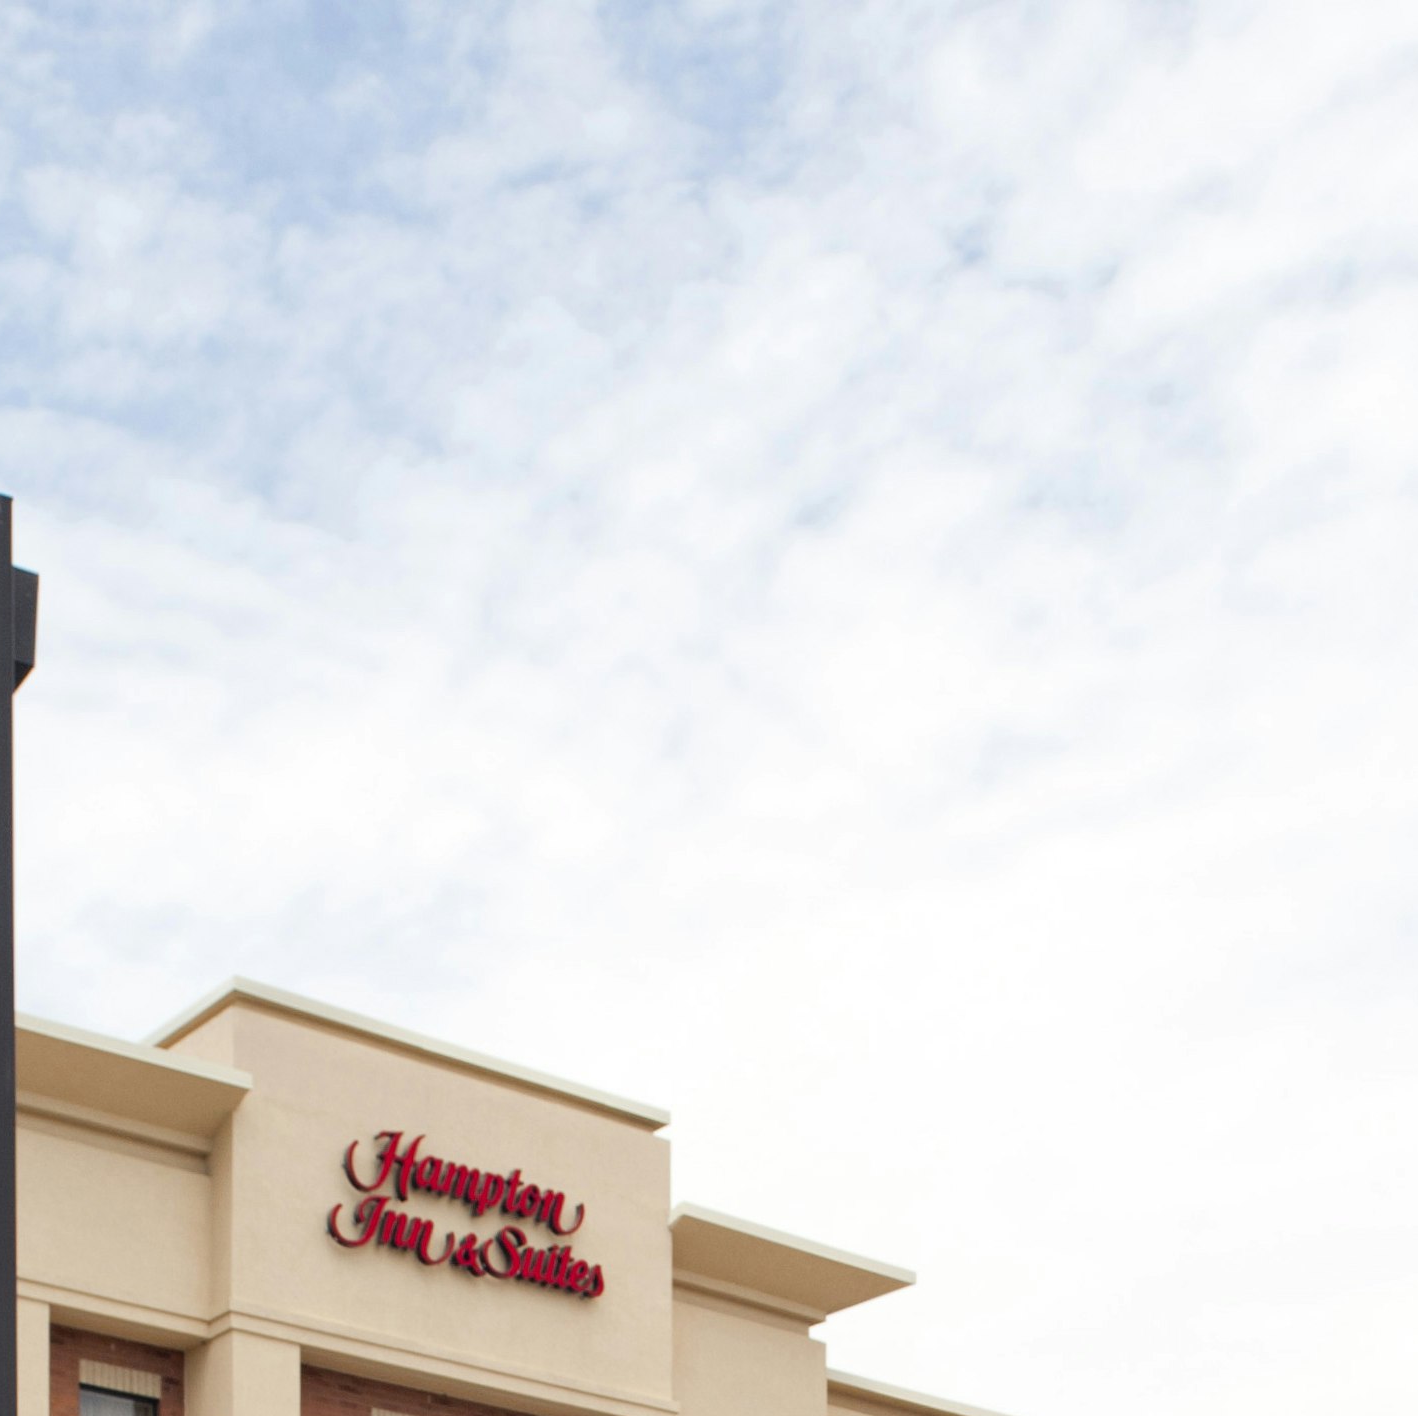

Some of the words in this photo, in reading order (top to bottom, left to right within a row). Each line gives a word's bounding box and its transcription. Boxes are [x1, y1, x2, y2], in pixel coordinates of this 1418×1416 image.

[343, 1130, 585, 1235] Hampton
[328, 1195, 454, 1265] Inn
[453, 1232, 485, 1276] &
[481, 1225, 605, 1299] Suites
